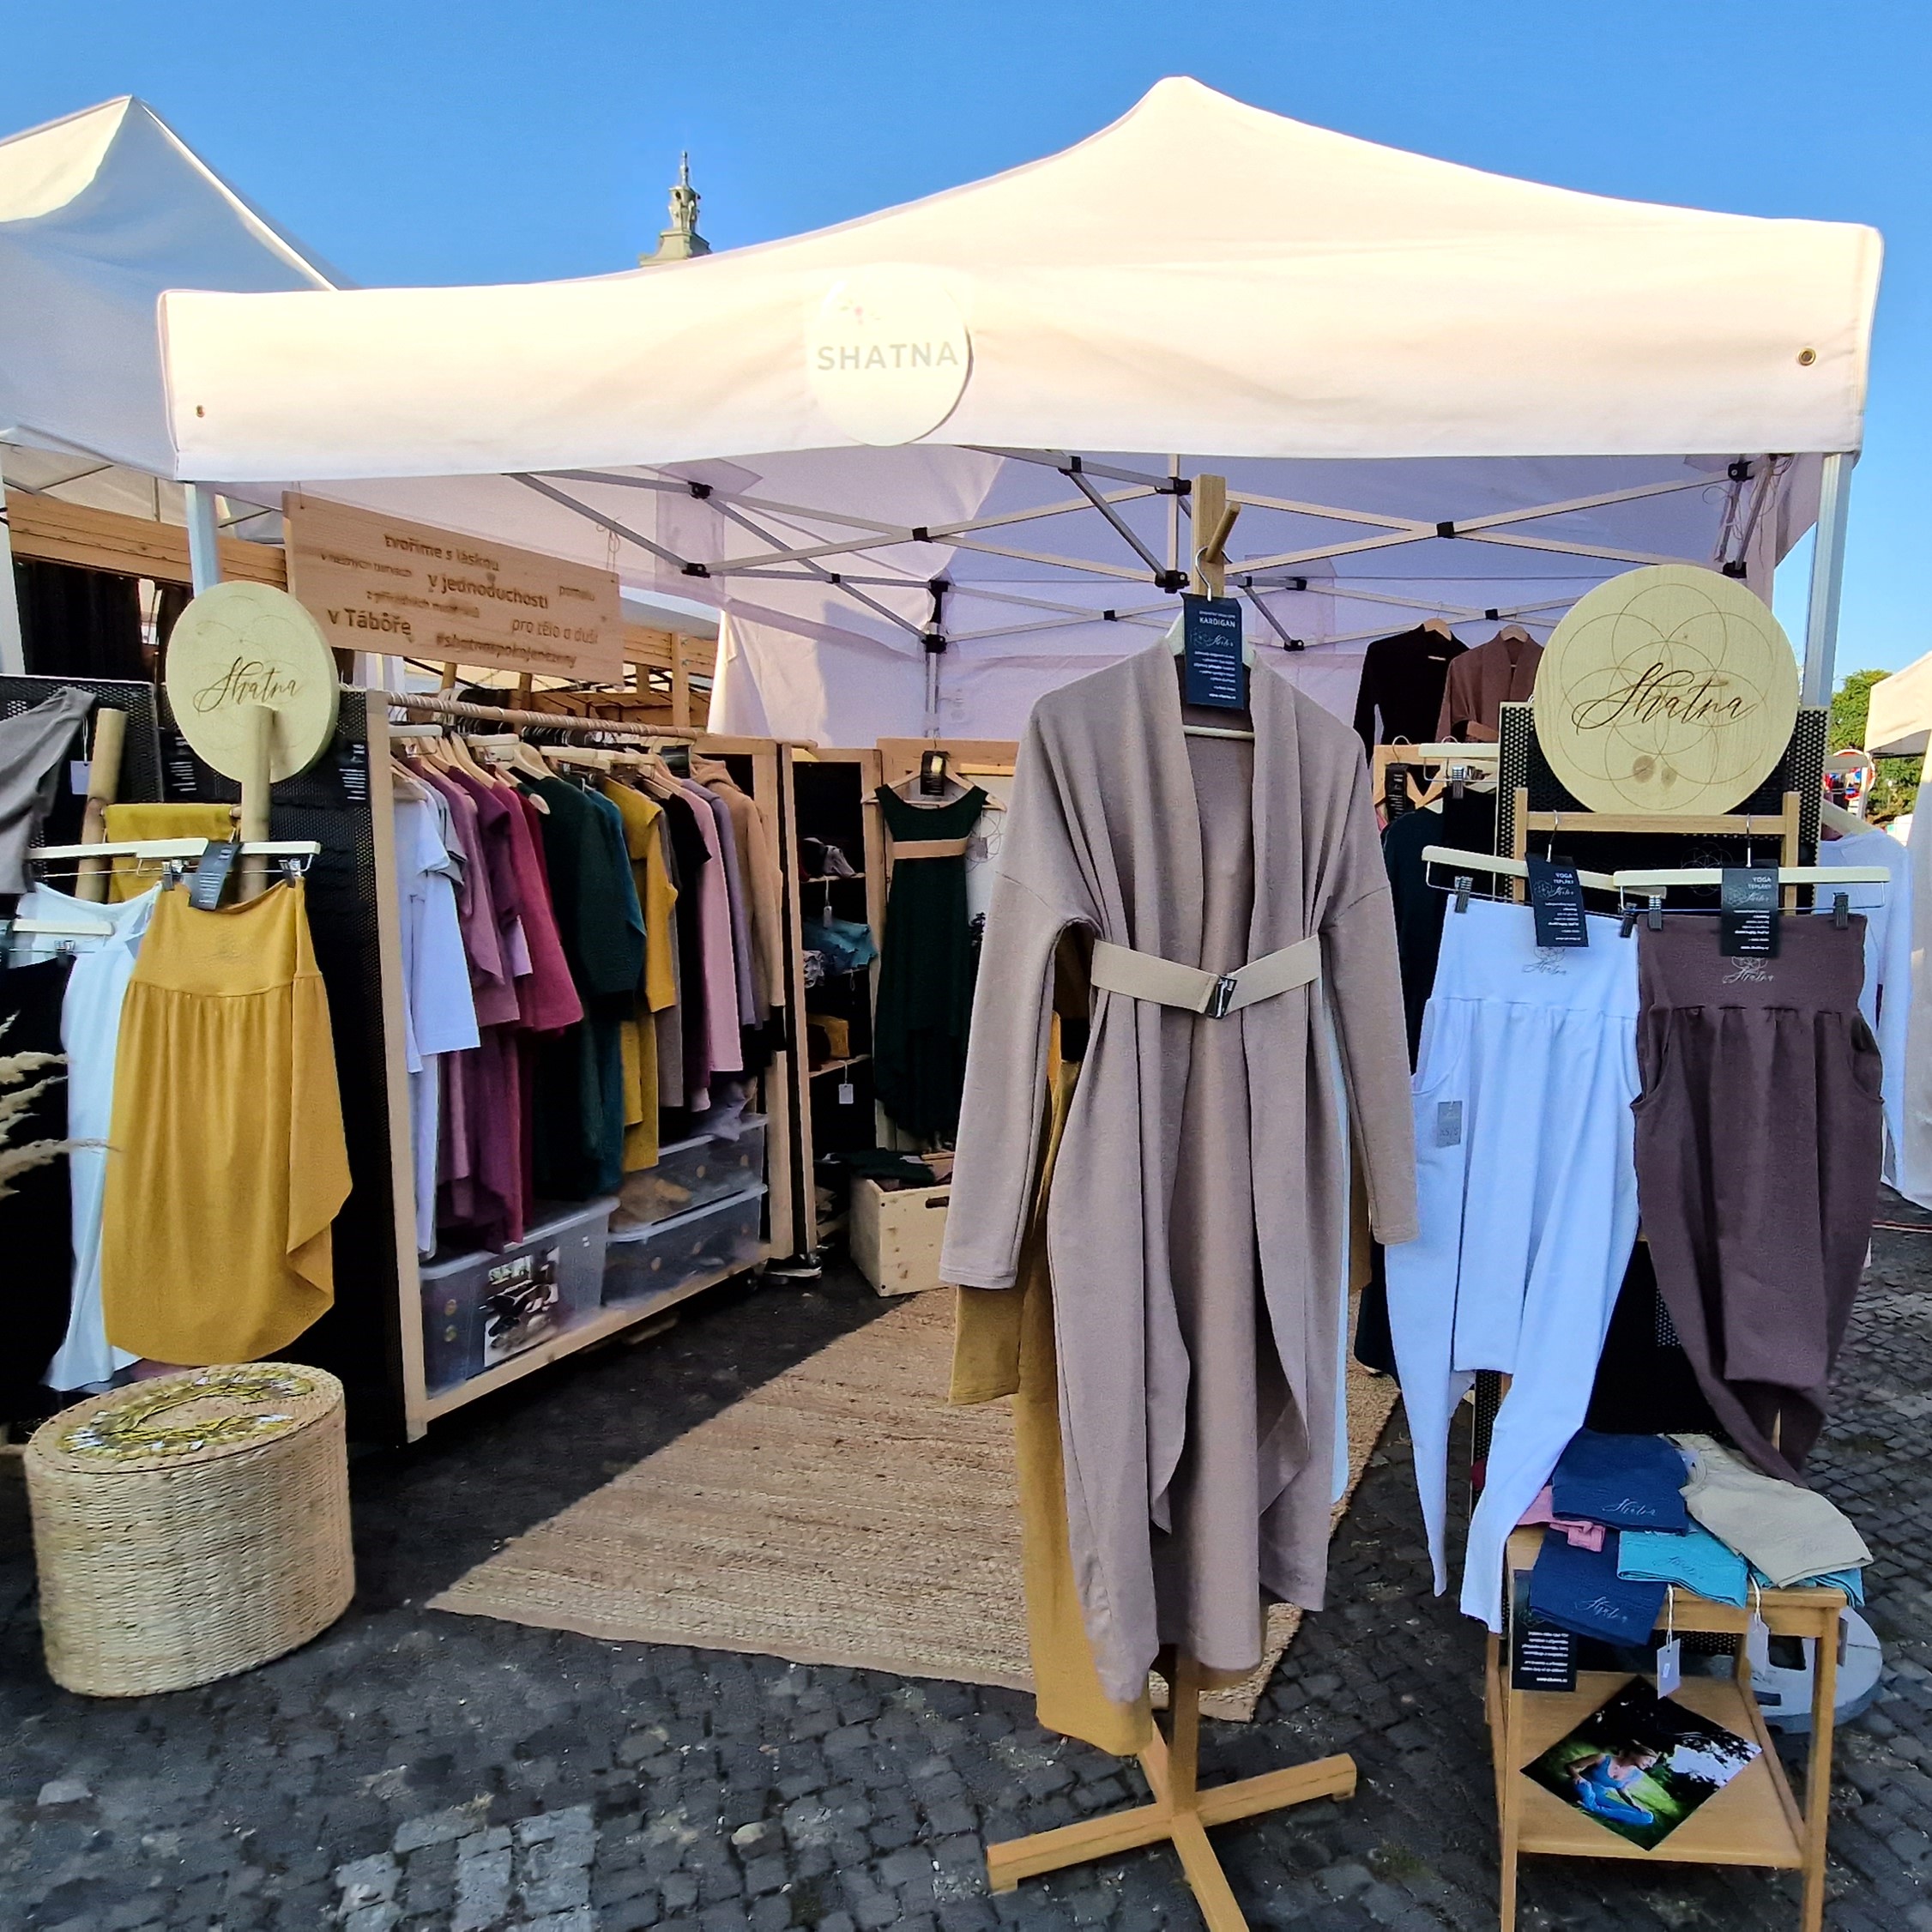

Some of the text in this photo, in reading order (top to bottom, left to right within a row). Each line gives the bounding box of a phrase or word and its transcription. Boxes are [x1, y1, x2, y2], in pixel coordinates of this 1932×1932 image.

[818, 341, 959, 371] SHATNA
[383, 534, 443, 558] tvoříme
[445, 549, 453, 561] s
[427, 574, 438, 588] v
[441, 574, 549, 609] jednoduchosti
[328, 607, 412, 636] v Táboře
[512, 619, 598, 644] pro tělo a duši
[1198, 616, 1236, 628] KARDIGAN
[193, 655, 300, 715] Shatna
[1571, 661, 1758, 736] Shatna
